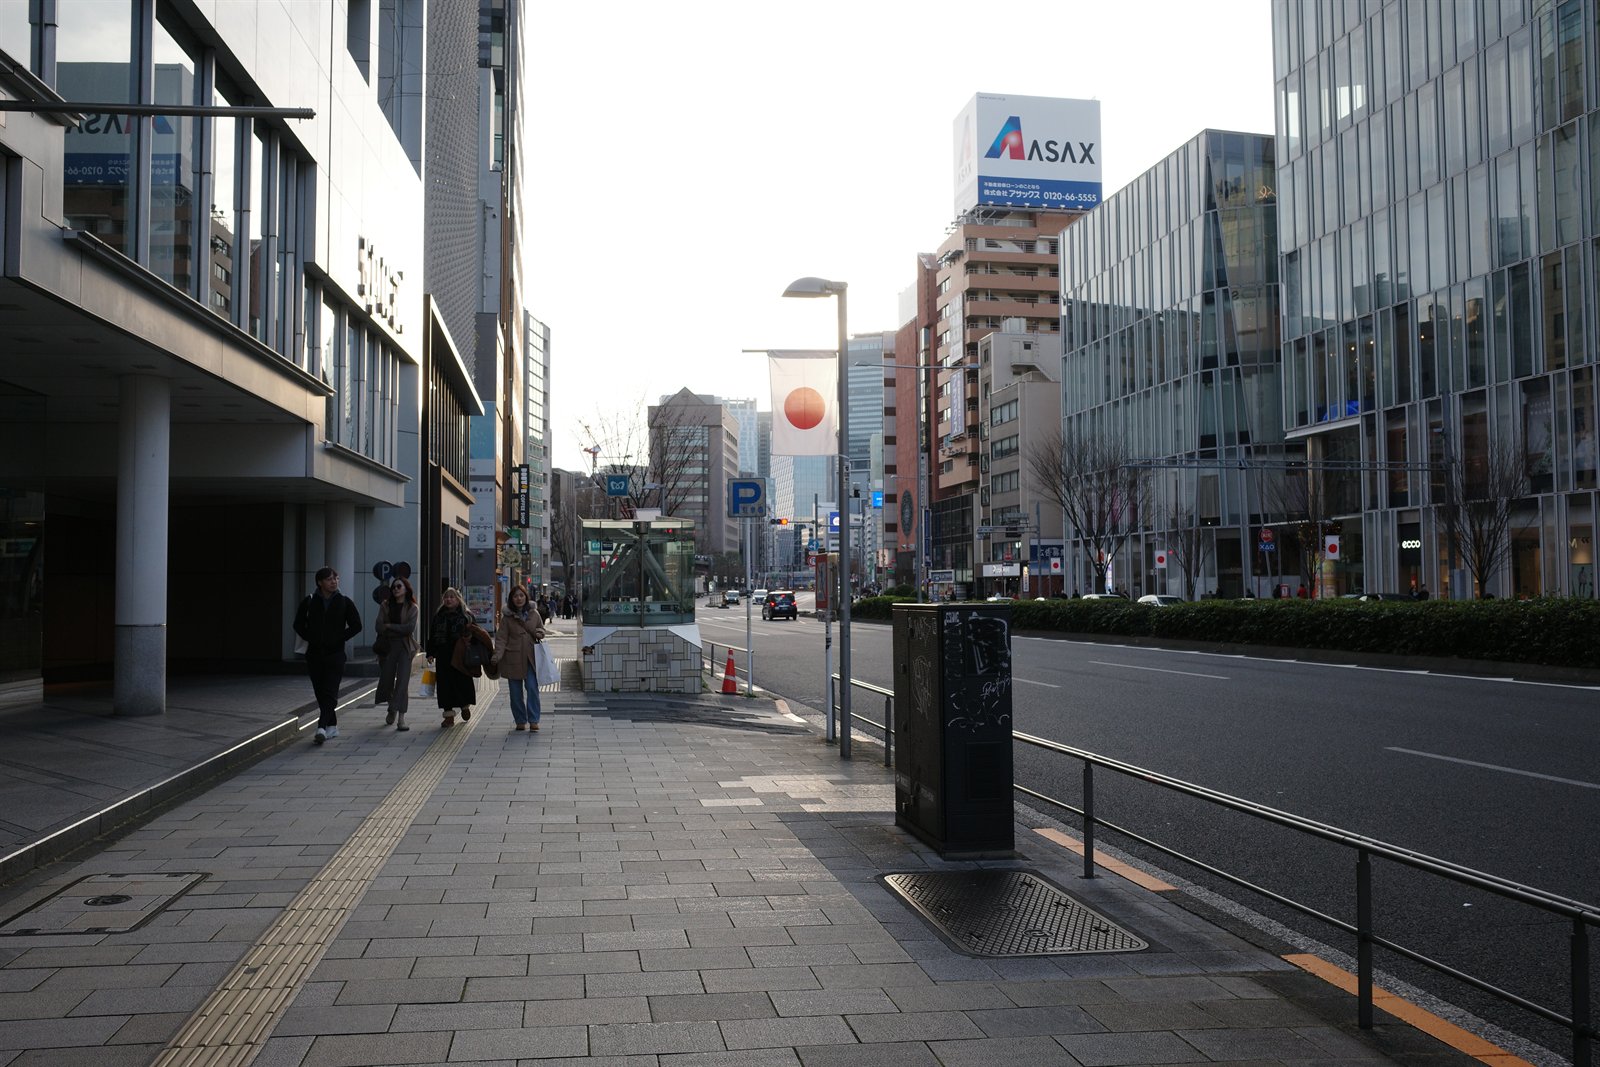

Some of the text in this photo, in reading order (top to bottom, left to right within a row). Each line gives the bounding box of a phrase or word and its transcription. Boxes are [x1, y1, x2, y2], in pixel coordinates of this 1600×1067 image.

[1028, 140, 1095, 165] ASAX
[1043, 192, 1097, 202] 0120-66-5555
[733, 482, 761, 514] P
[1401, 539, 1420, 548] ecco
[381, 564, 390, 579] P
